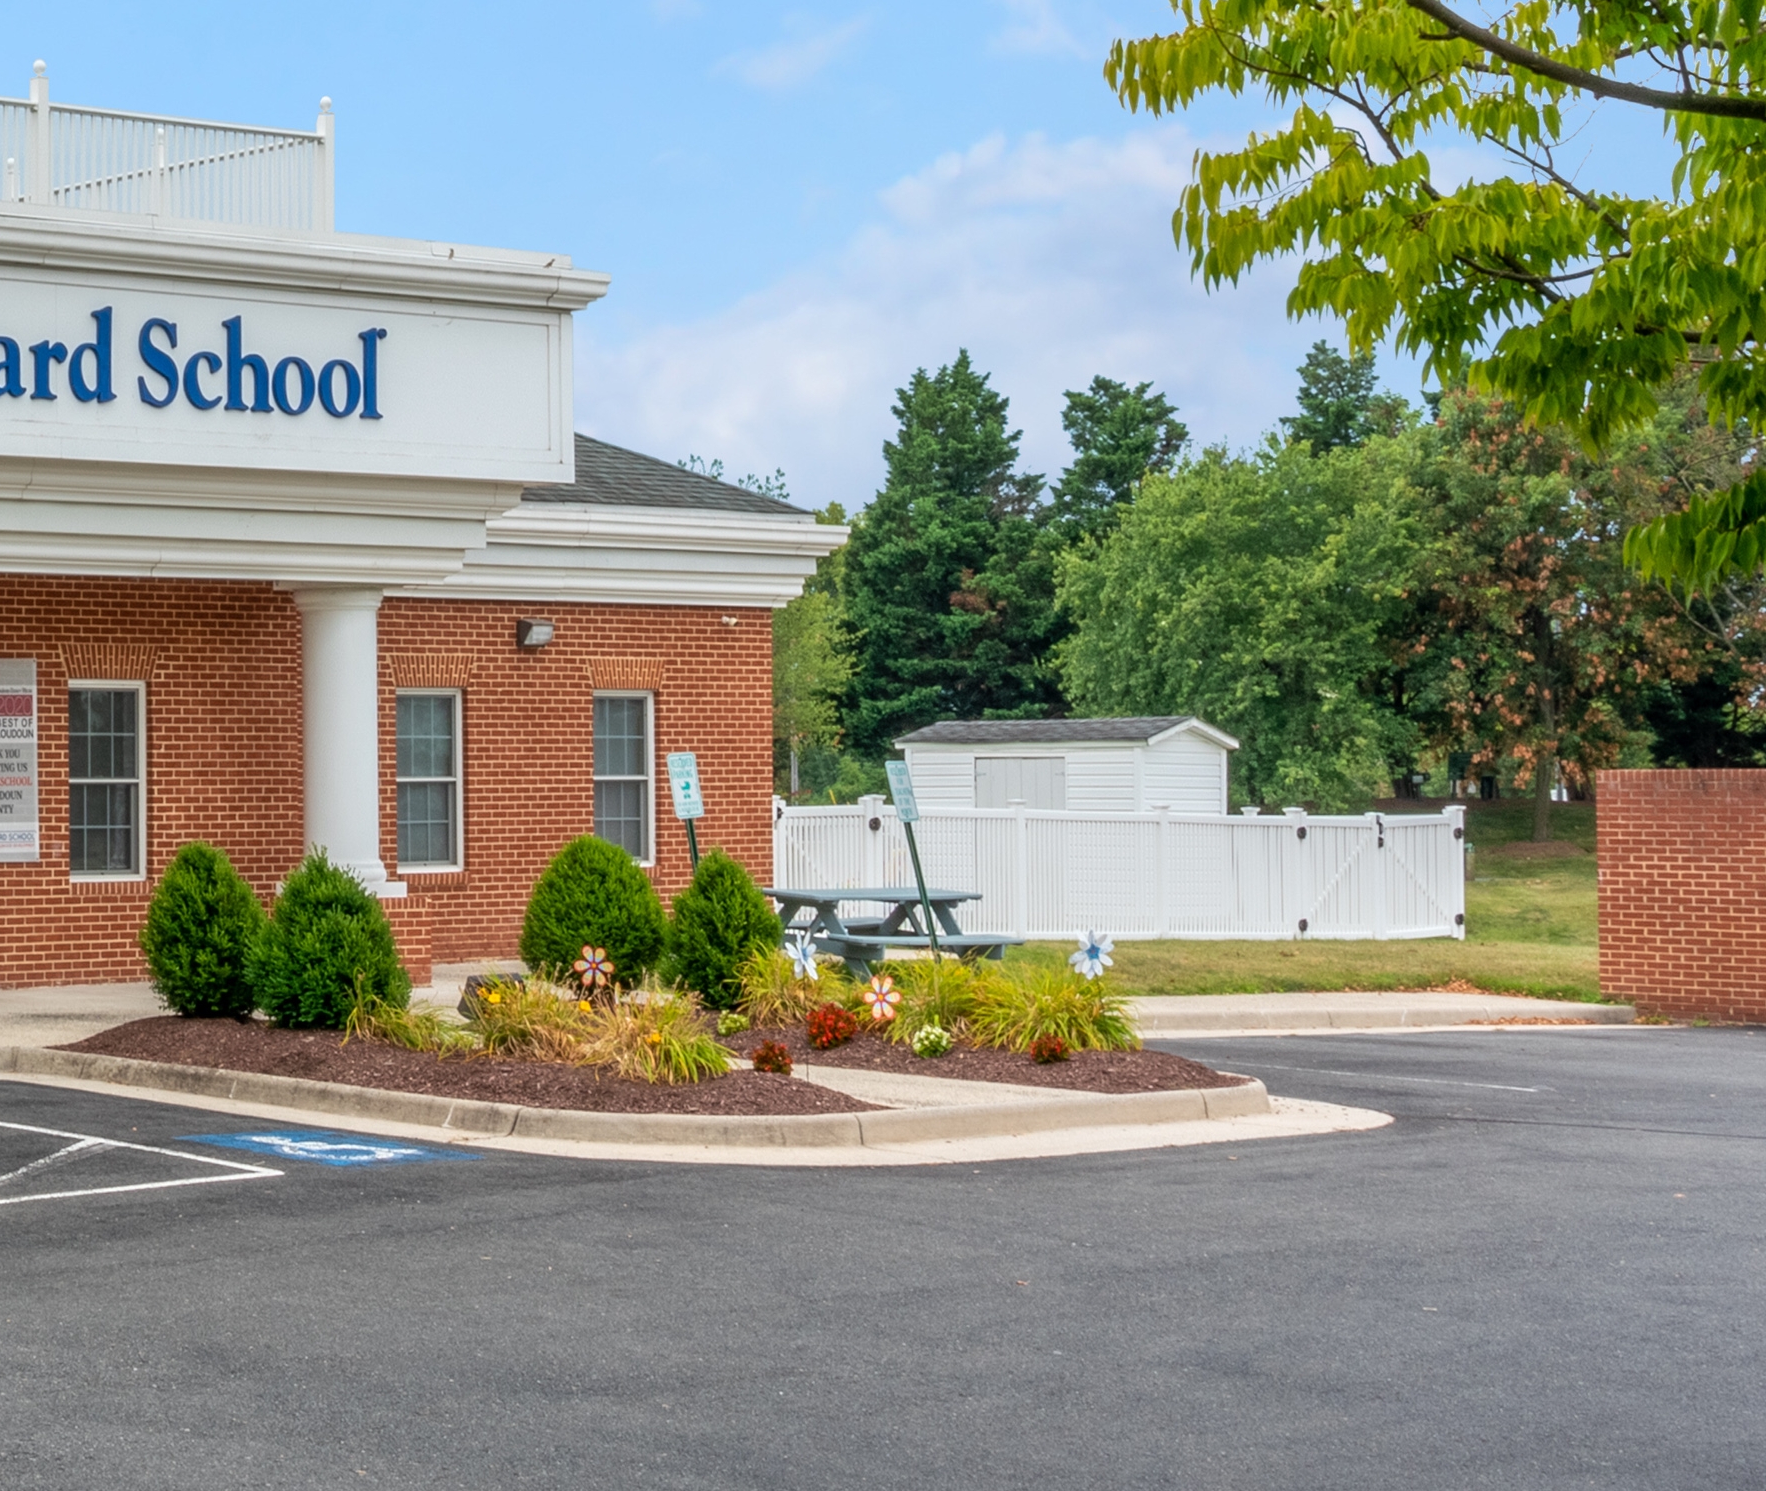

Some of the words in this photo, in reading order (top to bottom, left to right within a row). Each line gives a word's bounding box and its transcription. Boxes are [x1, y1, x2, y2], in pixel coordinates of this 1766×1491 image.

[137, 315, 384, 419] School
[21, 718, 33, 728] OF
[4, 749, 21, 758] YOU
[17, 763, 28, 772] US
[9, 832, 35, 841] SCHOOL
